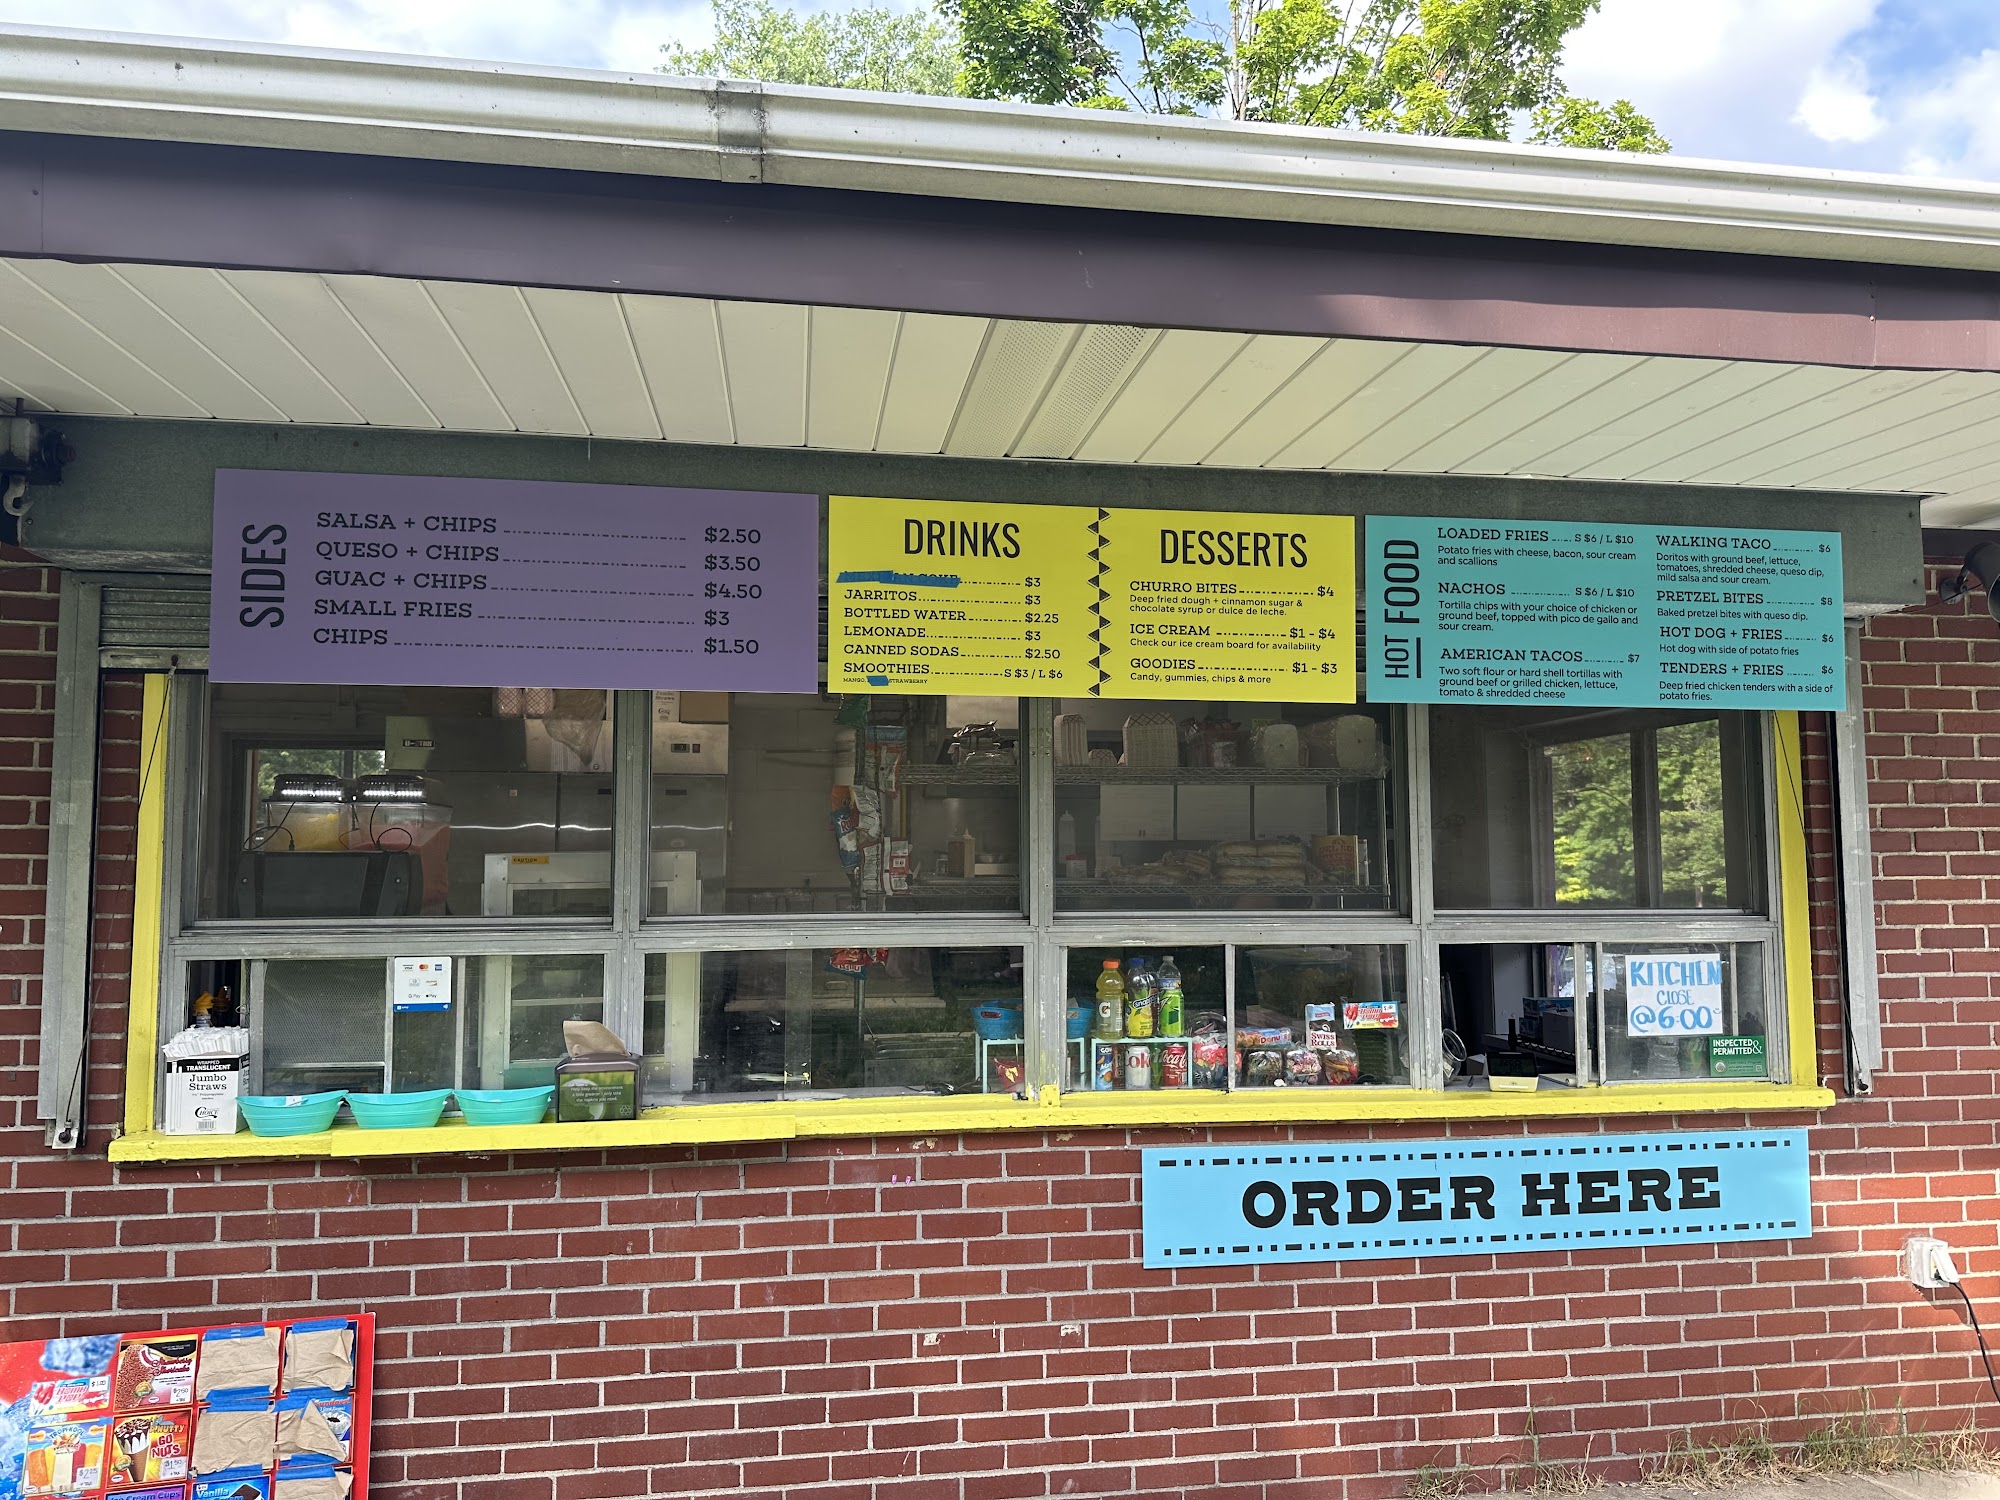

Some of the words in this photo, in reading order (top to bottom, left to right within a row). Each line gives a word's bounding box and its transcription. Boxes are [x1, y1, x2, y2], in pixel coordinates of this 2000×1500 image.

[316, 512, 397, 530] SALSA
[423, 515, 497, 534] CHIPS
[704, 525, 762, 544] $2.50
[1437, 527, 1501, 540] LOADED
[1504, 529, 1549, 542] FRIES
[1574, 533, 1582, 543] S
[1584, 533, 1597, 543] $6
[1606, 534, 1613, 544] L
[1615, 534, 1634, 545] $10
[904, 518, 1021, 559] DRINKS
[1655, 535, 1728, 548] WALKING
[1730, 537, 1771, 550] TACO
[1818, 543, 1831, 553] $6
[316, 541, 398, 561] QUESO
[425, 544, 499, 562] CHIPS
[704, 553, 761, 572] $3.50
[1160, 529, 1308, 568] DESSERTS
[1438, 545, 1470, 555] Potato
[1471, 546, 1492, 556] fries
[1493, 547, 1514, 556] with
[1516, 547, 1551, 559] cheese,
[1553, 548, 1584, 560] bacon,
[1608, 552, 1637, 560] cream
[240, 524, 288, 628] SIDES
[1024, 576, 1041, 588] $3
[1384, 539, 1420, 624] FOOD
[315, 570, 386, 588] GUAC
[413, 572, 487, 590] CHIPS
[704, 581, 762, 600] $4.50
[1129, 580, 1193, 593] CHURRO
[1196, 582, 1237, 594] BITES
[1317, 585, 1334, 598] $4
[1438, 582, 1506, 595] NACHOS
[1575, 587, 1582, 596] S
[1584, 587, 1598, 597] $6
[1606, 588, 1614, 597] L
[1615, 588, 1635, 598] $10
[844, 589, 917, 602] JARRITOS
[1025, 594, 1041, 606] $3
[1130, 594, 1154, 604] Deep
[1156, 595, 1178, 604] fried
[1180, 596, 1211, 606] dough
[1268, 600, 1294, 608] sugar
[1656, 590, 1720, 603] PRETZEL
[1722, 592, 1764, 605] BITES
[1820, 596, 1833, 606] $8
[314, 598, 397, 616] SMALL
[403, 601, 472, 619] FRIES
[704, 609, 730, 627] $3
[844, 607, 910, 619] BOTTLED
[913, 609, 967, 621] WATER
[1024, 612, 1059, 624] $2.25
[1129, 604, 1176, 613] chocolate
[1177, 606, 1204, 615] syrup
[1218, 606, 1244, 615] dulce
[1245, 607, 1258, 615] de
[1260, 607, 1287, 616] leche.
[844, 625, 926, 638] LEMONADE
[1025, 630, 1041, 642] $3
[1130, 623, 1155, 635] ICE
[1158, 624, 1211, 636] CREAM
[1289, 627, 1306, 640] $1
[1318, 627, 1336, 640] $4
[1659, 626, 1691, 638] HOT
[1694, 627, 1726, 639] DOG
[1741, 628, 1783, 640] FRIES
[1822, 633, 1834, 643] $6
[313, 628, 388, 645] CHIPS
[704, 636, 759, 655] $1.50
[1130, 638, 1159, 647] Check
[1179, 639, 1193, 648] ice
[1226, 640, 1254, 649] board
[1256, 641, 1270, 650] for
[1272, 642, 1321, 652] availability
[843, 644, 907, 656] CANNED
[910, 645, 959, 657] SODAS
[1025, 647, 1061, 660] $2.50
[1384, 634, 1410, 678] HOT
[1440, 648, 1527, 661] AMERICAN
[1530, 650, 1583, 663] TACOS
[1627, 653, 1640, 664] $7
[843, 662, 930, 675] SMOOTHIES
[1004, 668, 1012, 678] S
[1014, 668, 1029, 679] $3
[1038, 669, 1046, 679] L
[1048, 668, 1063, 680] $6
[1130, 658, 1196, 670] GOODIES
[1292, 661, 1308, 674] $1
[1321, 662, 1338, 675] $3
[1659, 662, 1727, 675] TENDERS
[1743, 664, 1784, 676] FRIES
[1821, 664, 1834, 675] $6
[1130, 672, 1162, 683] Candy,
[1164, 674, 1209, 683] gummies,
[1211, 674, 1236, 684] chips
[1630, 960, 1722, 987] KITCHEN
[1656, 990, 1694, 1006] CLOSE
[1311, 1032, 1335, 1040] SWISS
[1712, 1038, 1752, 1047] INSPECTED
[1713, 1047, 1752, 1055] PERMITTED
[189, 1074, 227, 1082] Jumbo
[1242, 1174, 1496, 1229] ORDER
[1521, 1165, 1721, 1218] HERE
[158, 1433, 173, 1445] GO
[151, 1444, 182, 1458] NUTS
[158, 1491, 180, 1500] Cups
[197, 1488, 229, 1498] Vanilla
